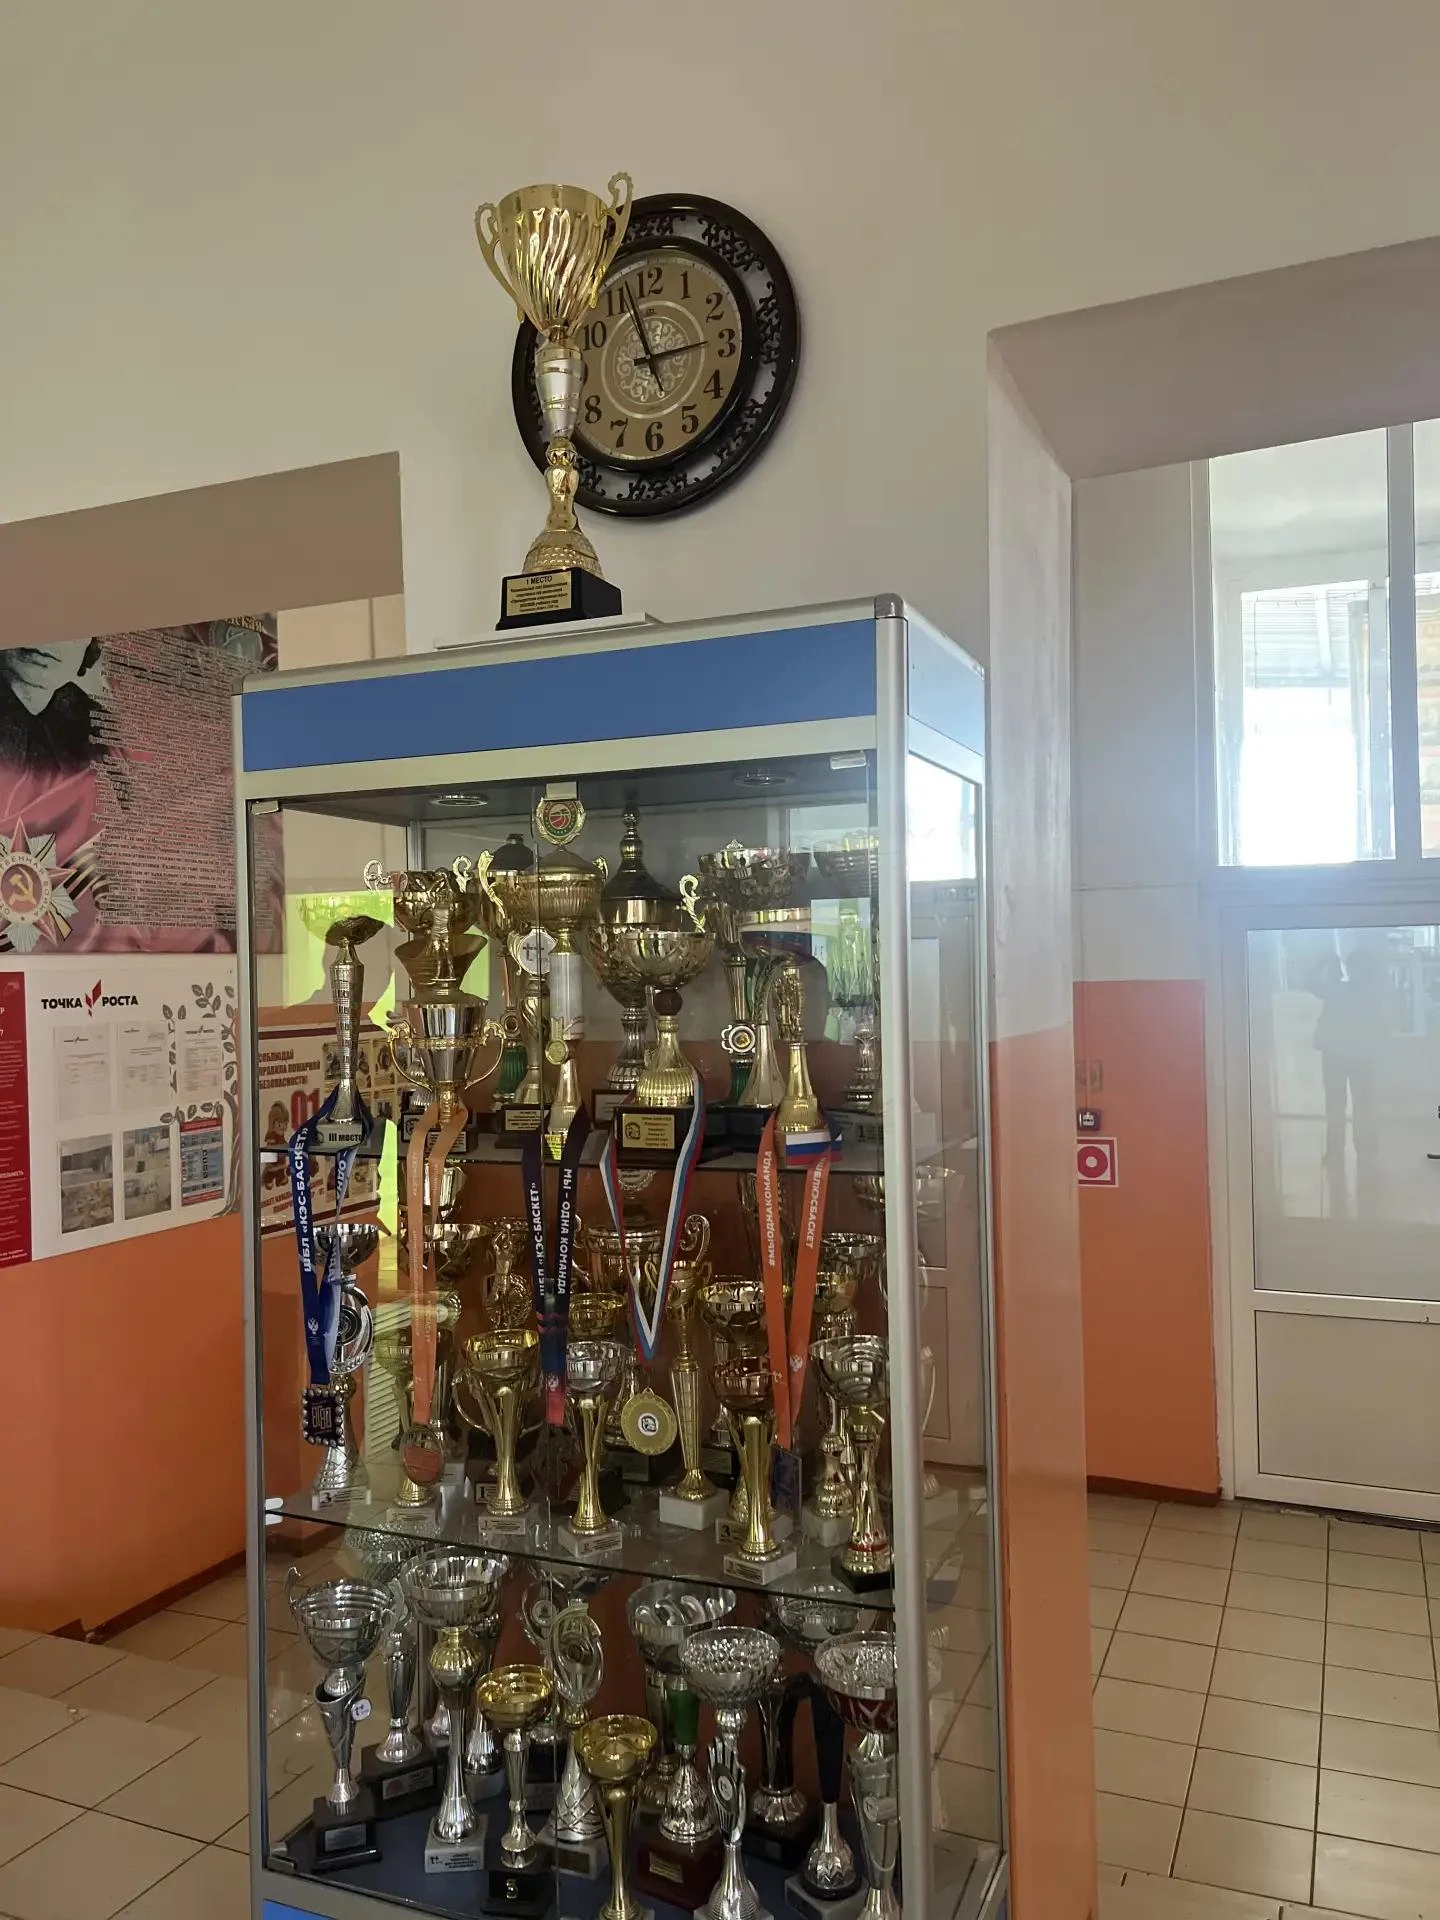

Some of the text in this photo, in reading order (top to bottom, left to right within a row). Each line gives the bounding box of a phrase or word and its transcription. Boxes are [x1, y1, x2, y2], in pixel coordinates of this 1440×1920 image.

[638, 267, 664, 299] 12
[680, 271, 690, 300] 1
[606, 288, 626, 318] 11
[706, 292, 724, 323] 2
[582, 320, 607, 350] 10
[718, 328, 736, 358] 3
[703, 369, 724, 400] 4
[584, 395, 602, 423] 8
[681, 404, 699, 434] 5
[610, 417, 628, 448] 7
[645, 421, 664, 451] 6
[531, 575, 553, 584] МЕСТО
[41, 995, 139, 1010] ТОЧКА РОСТА
[290, 1088, 321, 1132] 01
[562, 1168, 573, 1190] МЫ
[560, 1201, 571, 1234] ОДНА
[301, 1238, 312, 1272] ШБЛ
[557, 1237, 569, 1295] КОМАНДА
